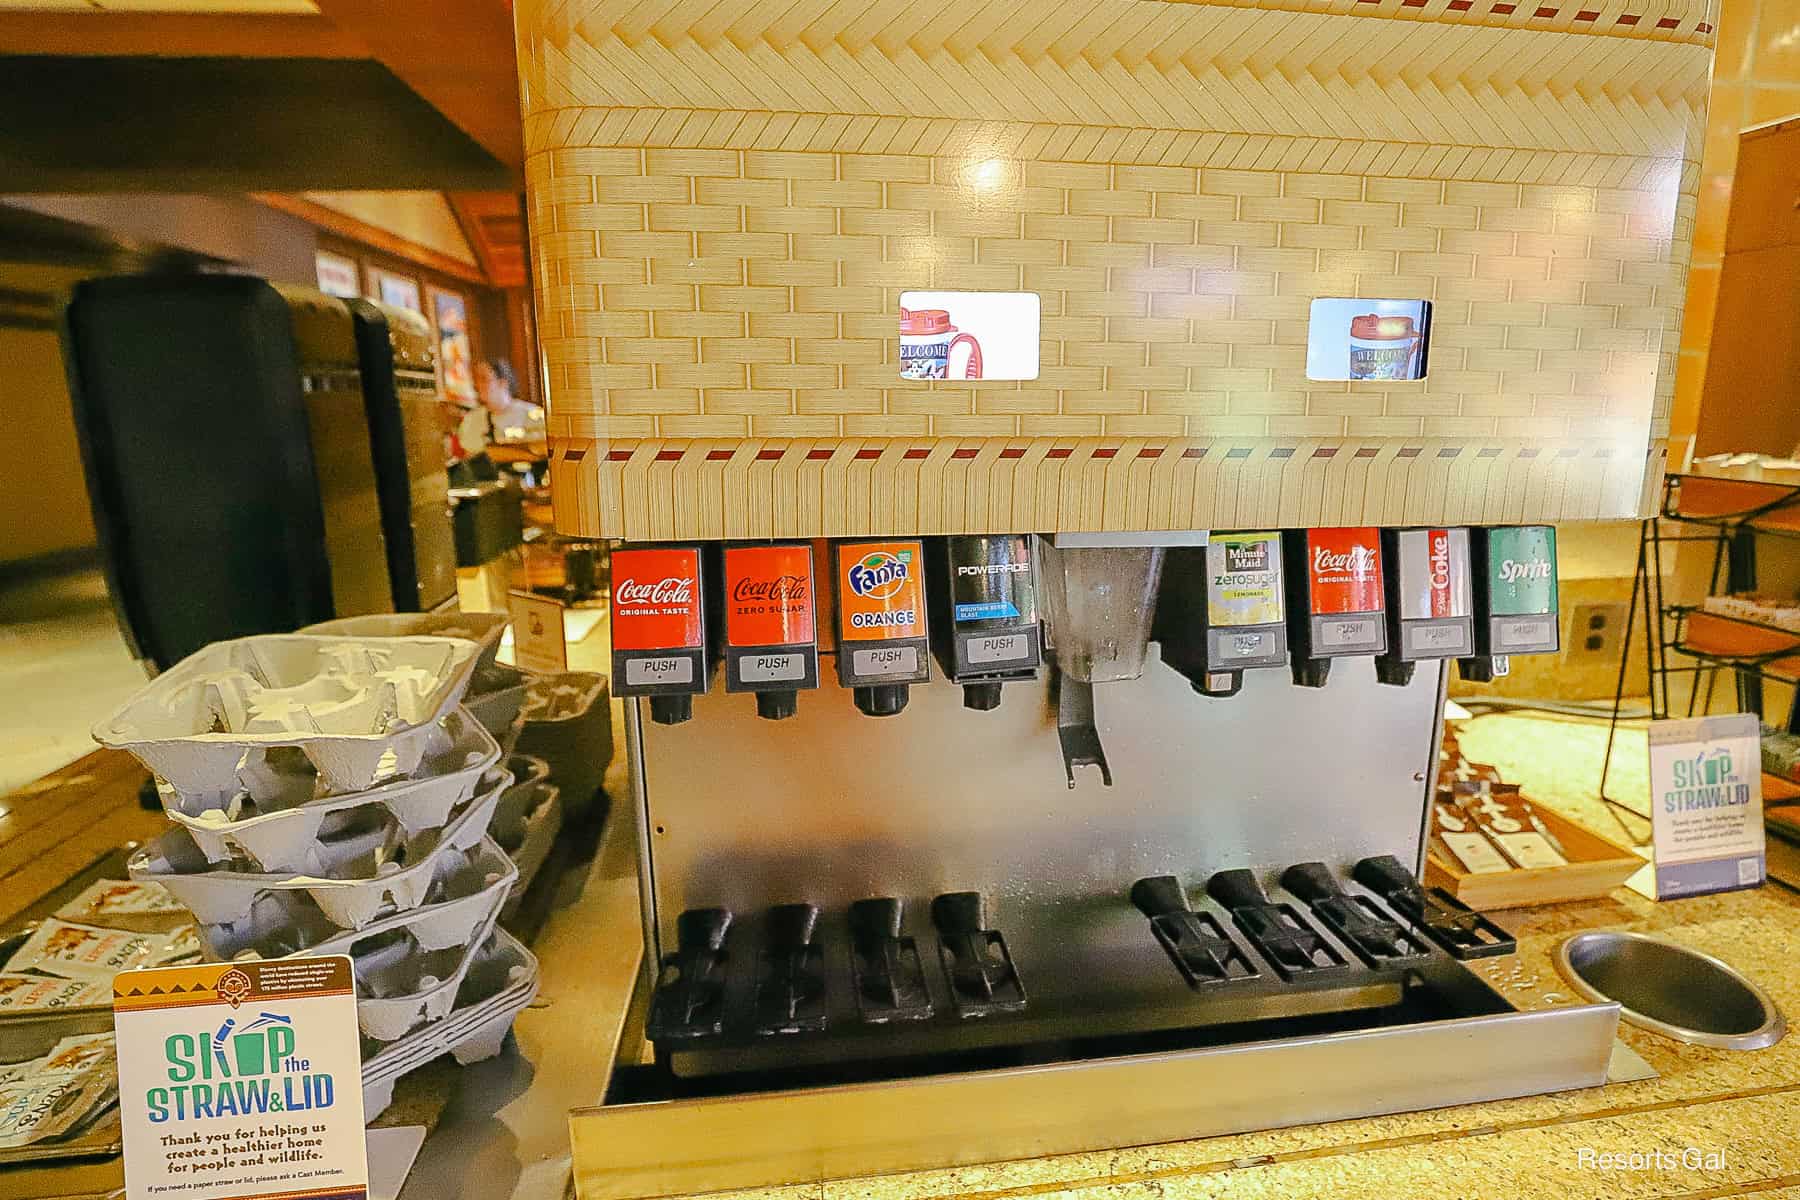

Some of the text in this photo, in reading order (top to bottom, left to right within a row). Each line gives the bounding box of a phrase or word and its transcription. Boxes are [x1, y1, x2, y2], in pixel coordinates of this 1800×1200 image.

[900, 344, 948, 358] ELCOME
[1229, 549, 1266, 559] Minute
[958, 563, 1029, 576] POWERADE
[1235, 558, 1261, 569] Maid
[1431, 536, 1449, 590] Coke
[848, 559, 908, 597] Fanta
[1498, 559, 1552, 583] Sprite
[1318, 575, 1353, 584] ORIGINAL
[616, 578, 694, 605] Coca-Cola
[734, 576, 808, 602] Coca-Cola
[620, 607, 689, 616] ORIGINAL TASTE
[737, 607, 765, 615] ZERO
[852, 610, 916, 628] ORANGE
[984, 638, 1014, 650] PUSH
[757, 657, 790, 669] PUSH
[871, 651, 902, 662] PUSH
[644, 660, 678, 672] PUSH
[284, 1056, 310, 1073] the
[160, 1123, 327, 1147] Thank you for helping us
[166, 1137, 323, 1160] create a healthier home
[167, 1149, 324, 1174] for people and wildlife.
[154, 1185, 168, 1194] you
[168, 1182, 186, 1191] need
[193, 1180, 214, 1189] paper
[215, 1178, 234, 1187] straw
[255, 1174, 278, 1184] please
[279, 1172, 291, 1180] ask
[297, 1170, 314, 1179] Cast
